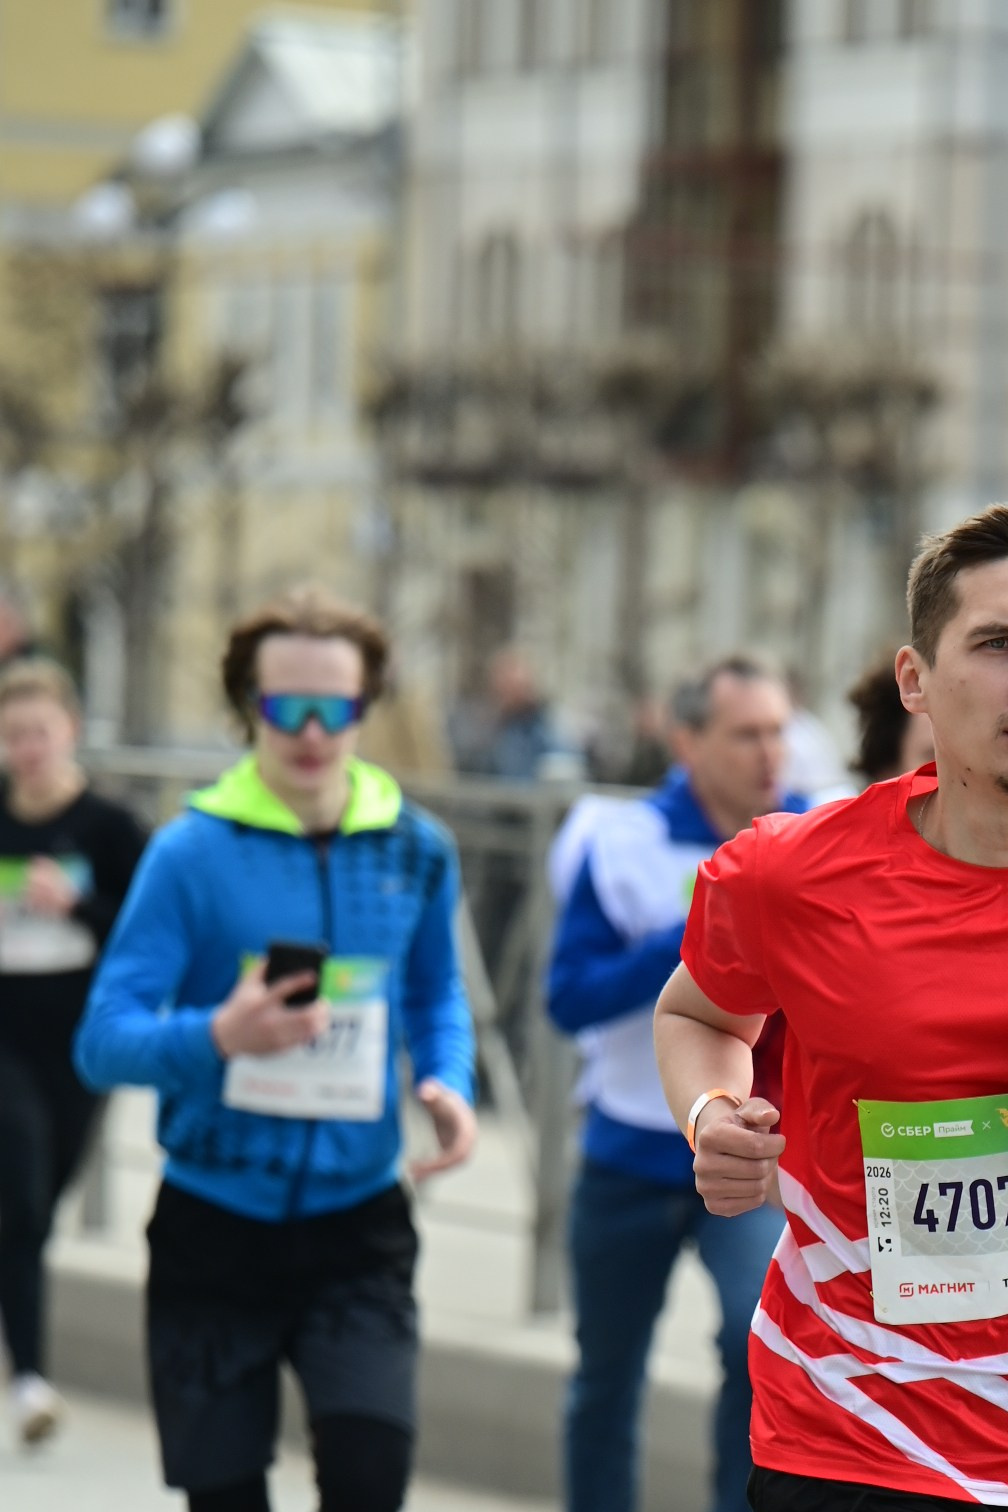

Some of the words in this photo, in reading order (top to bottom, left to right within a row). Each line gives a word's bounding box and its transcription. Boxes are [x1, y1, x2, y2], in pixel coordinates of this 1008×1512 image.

[897, 1126, 932, 1136] СБЕР
[938, 1123, 967, 1134] Прайм
[866, 1166, 891, 1178] 2026
[878, 1188, 892, 1228] 12:20
[918, 1282, 975, 1295] МАГНИТ
